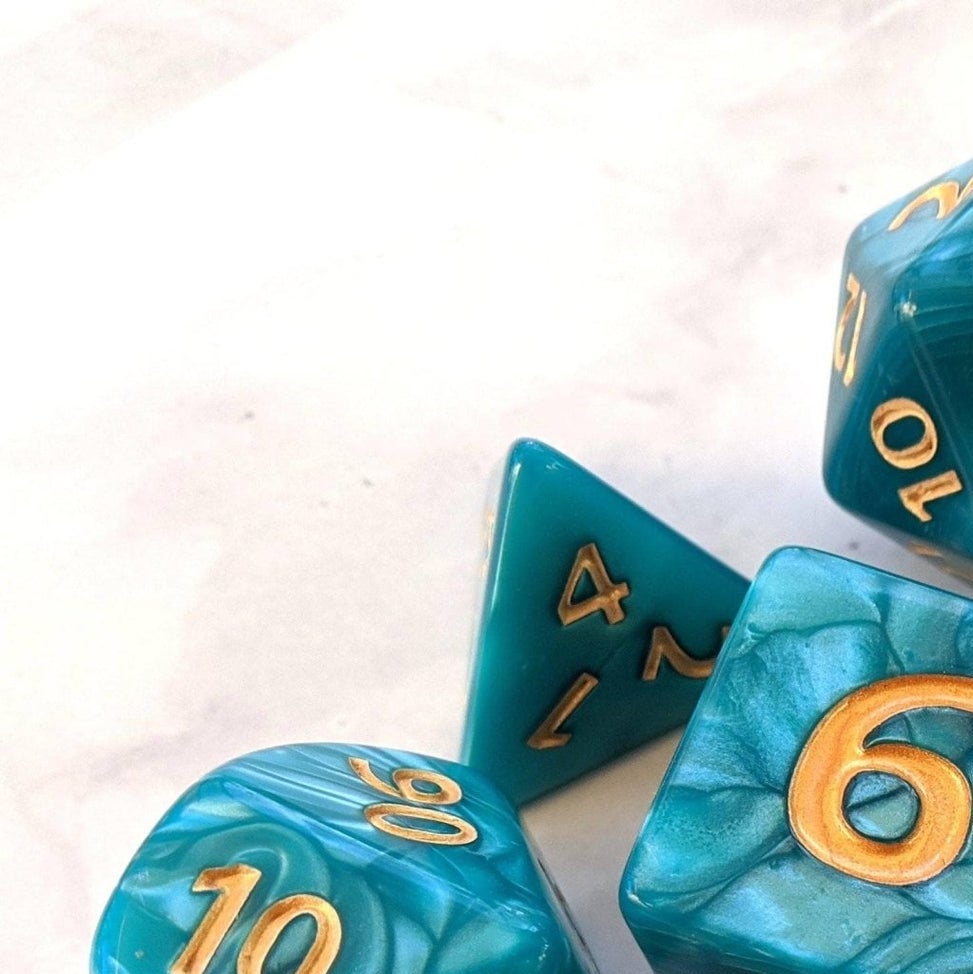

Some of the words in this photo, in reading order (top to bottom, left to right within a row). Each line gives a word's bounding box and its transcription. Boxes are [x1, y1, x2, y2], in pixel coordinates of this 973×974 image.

[871, 397, 963, 523] 10
[557, 542, 630, 626] 4
[526, 672, 599, 750] 1
